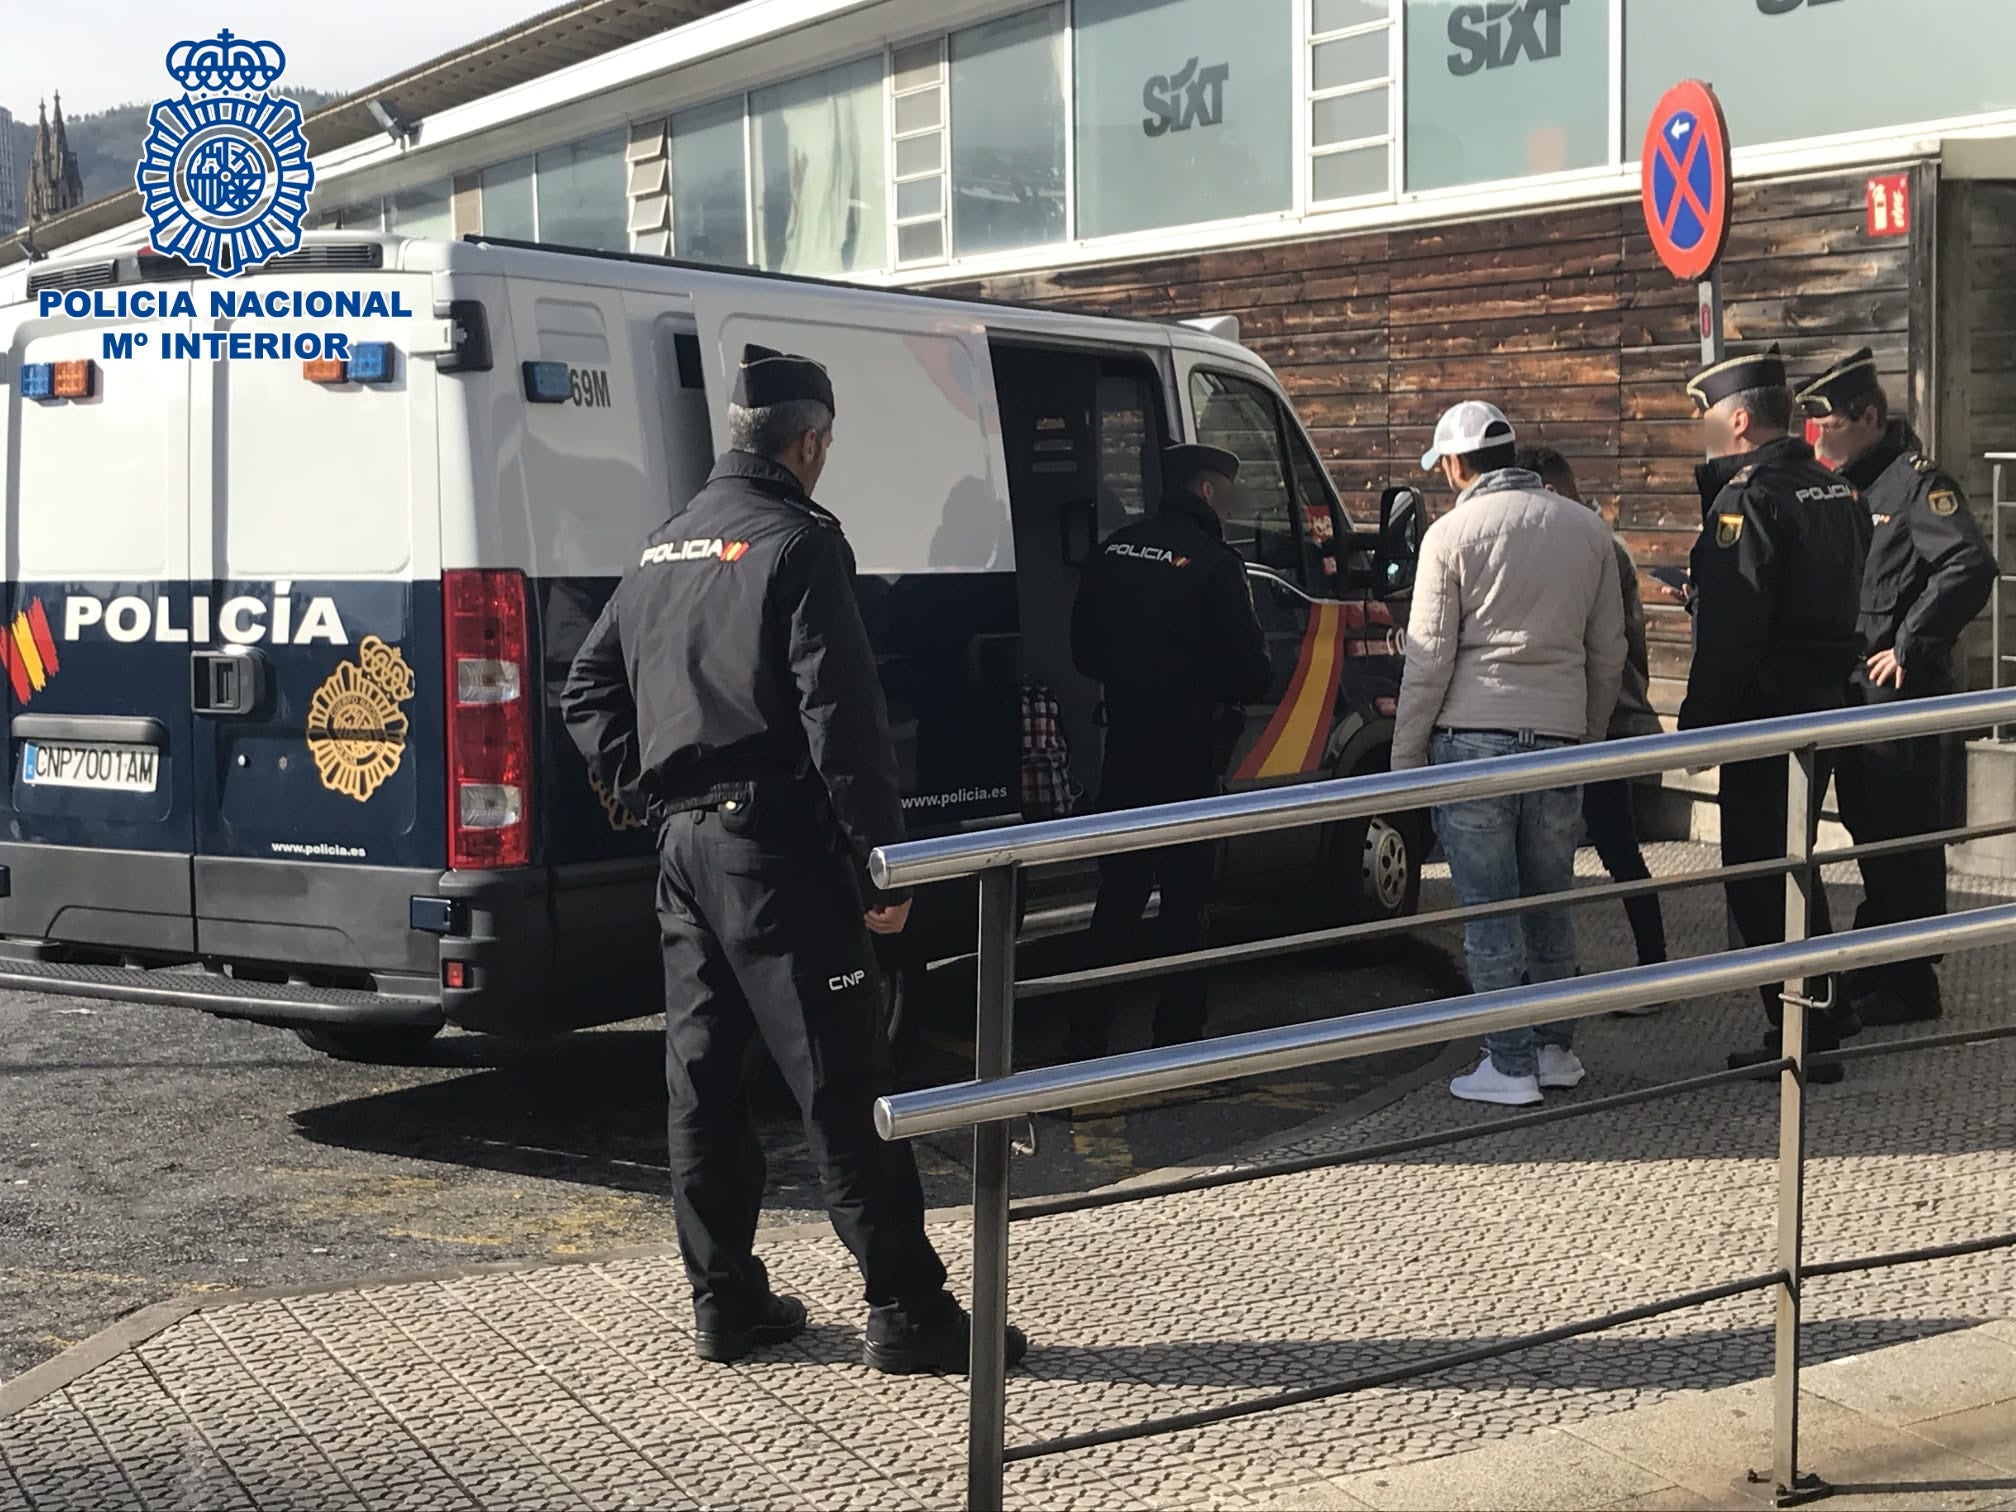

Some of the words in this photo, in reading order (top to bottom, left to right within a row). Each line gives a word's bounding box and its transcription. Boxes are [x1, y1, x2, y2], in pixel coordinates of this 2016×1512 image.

[1447, 0, 1571, 76] SIXT
[1143, 56, 1229, 138] SIXT
[640, 538, 722, 567] POLICIA
[1105, 544, 1172, 563] POLICIA
[64, 580, 349, 645] POLICÍA
[35, 746, 154, 784] CNP7001AM
[901, 787, 1007, 808] www.policia.es
[271, 843, 366, 857] www.policia.es
[829, 970, 865, 990] CNP
